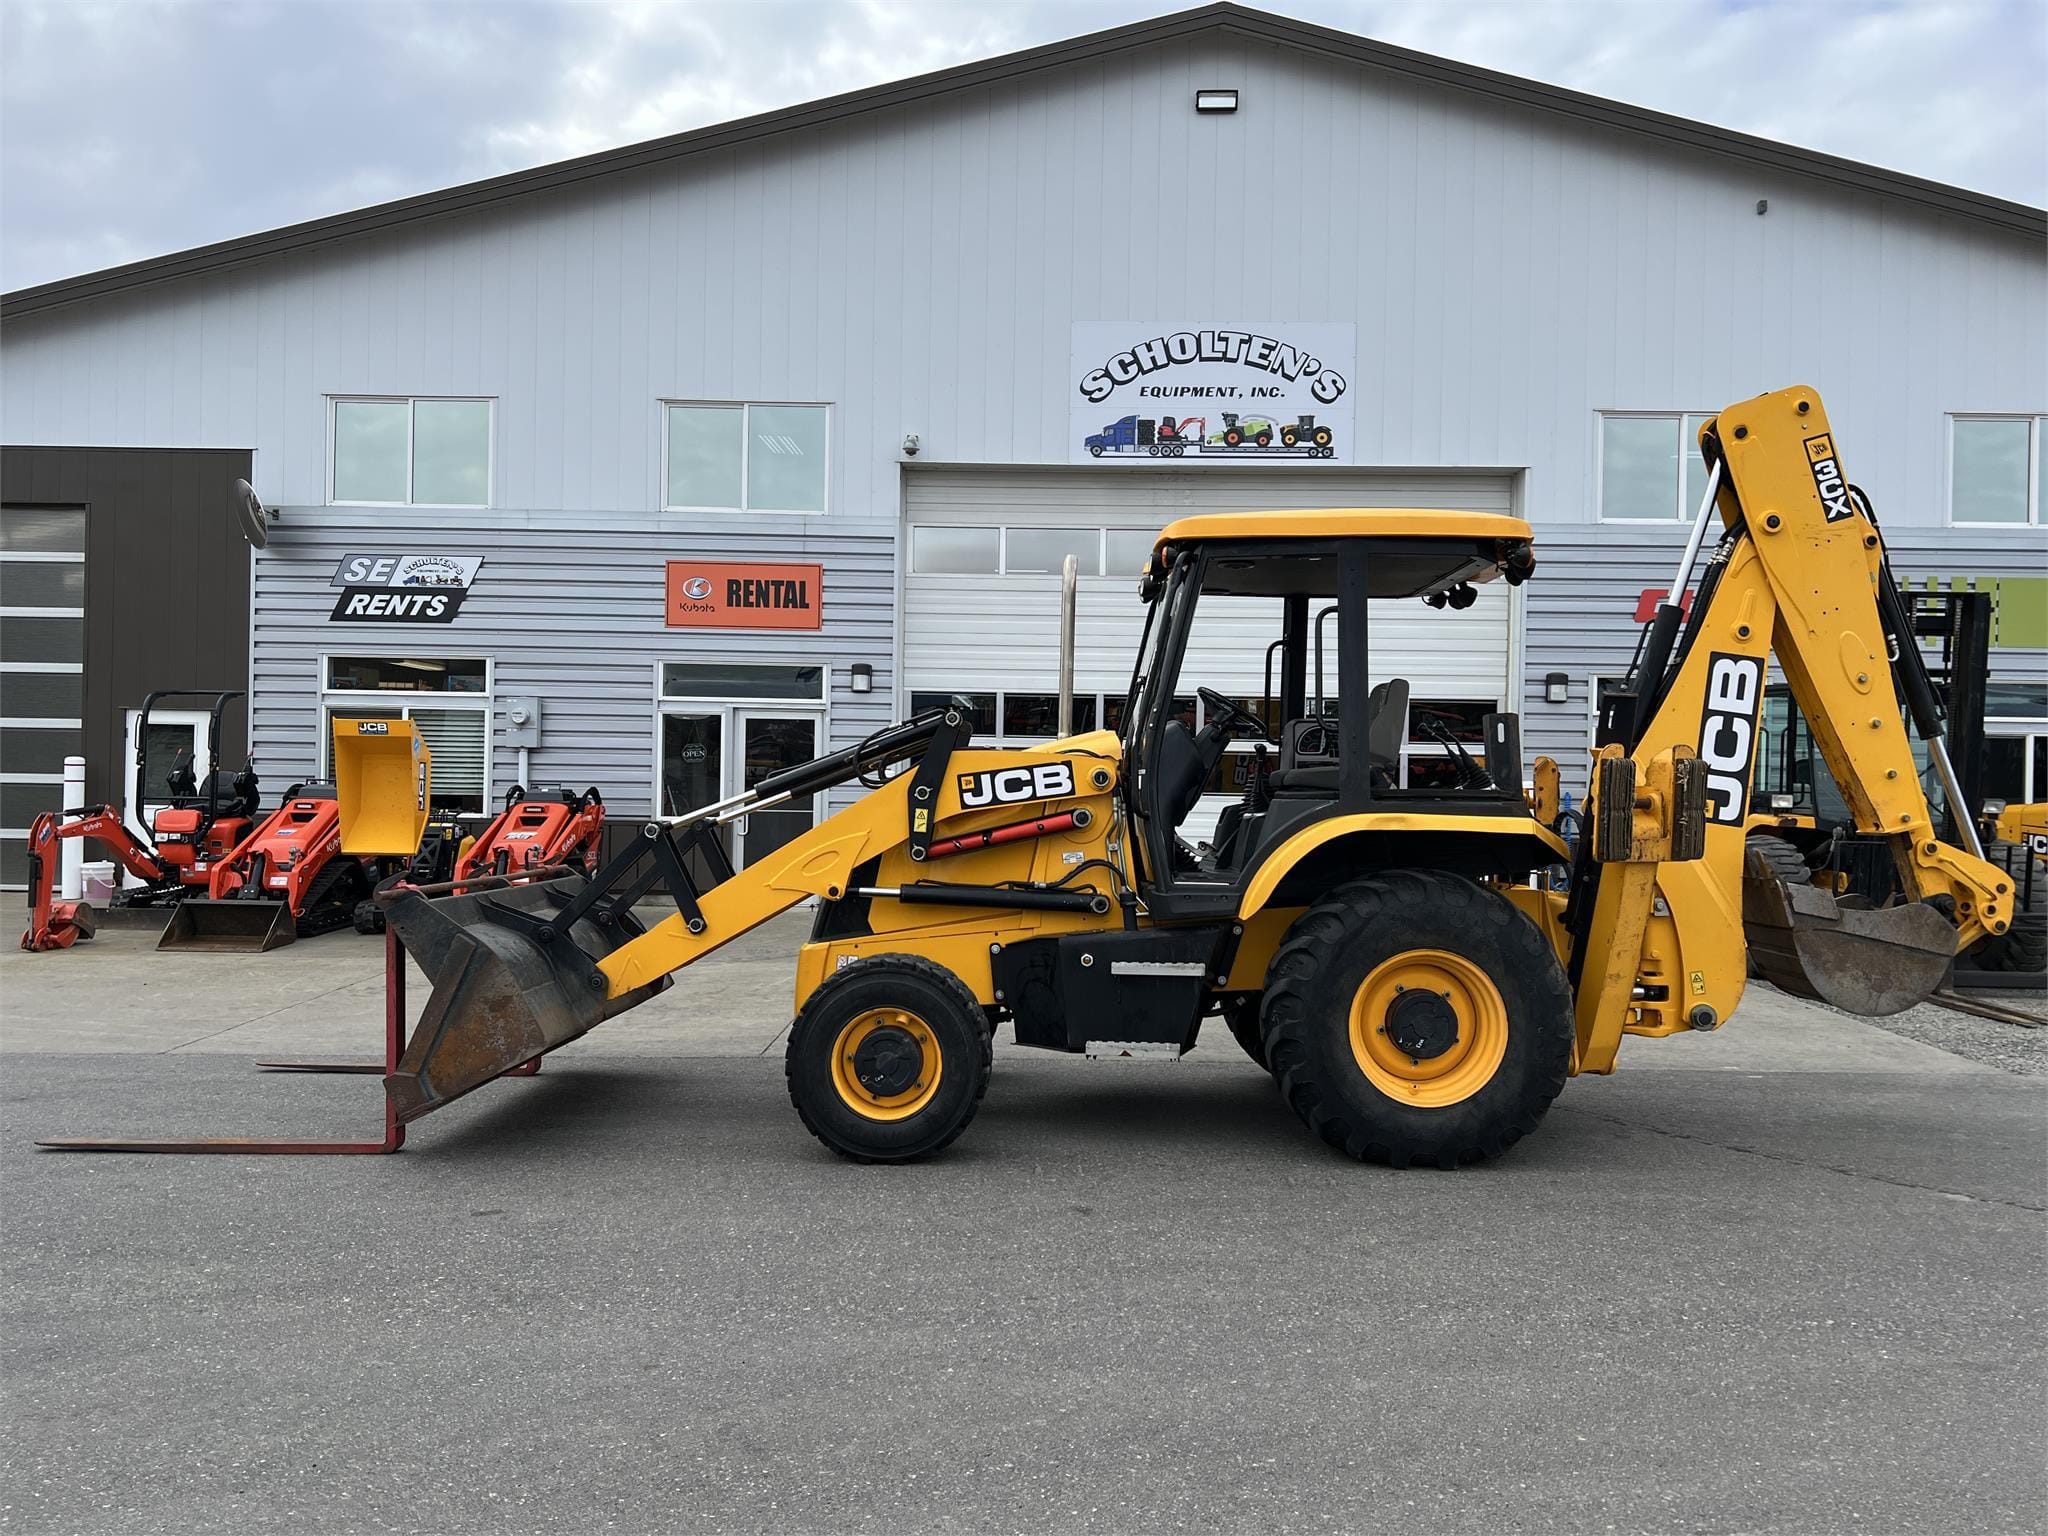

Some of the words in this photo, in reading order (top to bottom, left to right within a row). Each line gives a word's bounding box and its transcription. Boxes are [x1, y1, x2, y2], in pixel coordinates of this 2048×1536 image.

[1080, 330, 1347, 404] SCHOLTEN'S
[1139, 386, 1243, 399] EQUIPMENT,
[1250, 386, 1286, 398] INC.
[1814, 459, 1852, 519] 3CX
[343, 557, 397, 582] SE
[344, 594, 449, 616] RENTS
[679, 602, 715, 613] Kubota
[727, 579, 810, 609] RENTAL
[359, 723, 388, 731] JCB
[1702, 658, 1758, 821] JCB
[963, 764, 1073, 806] JCB
